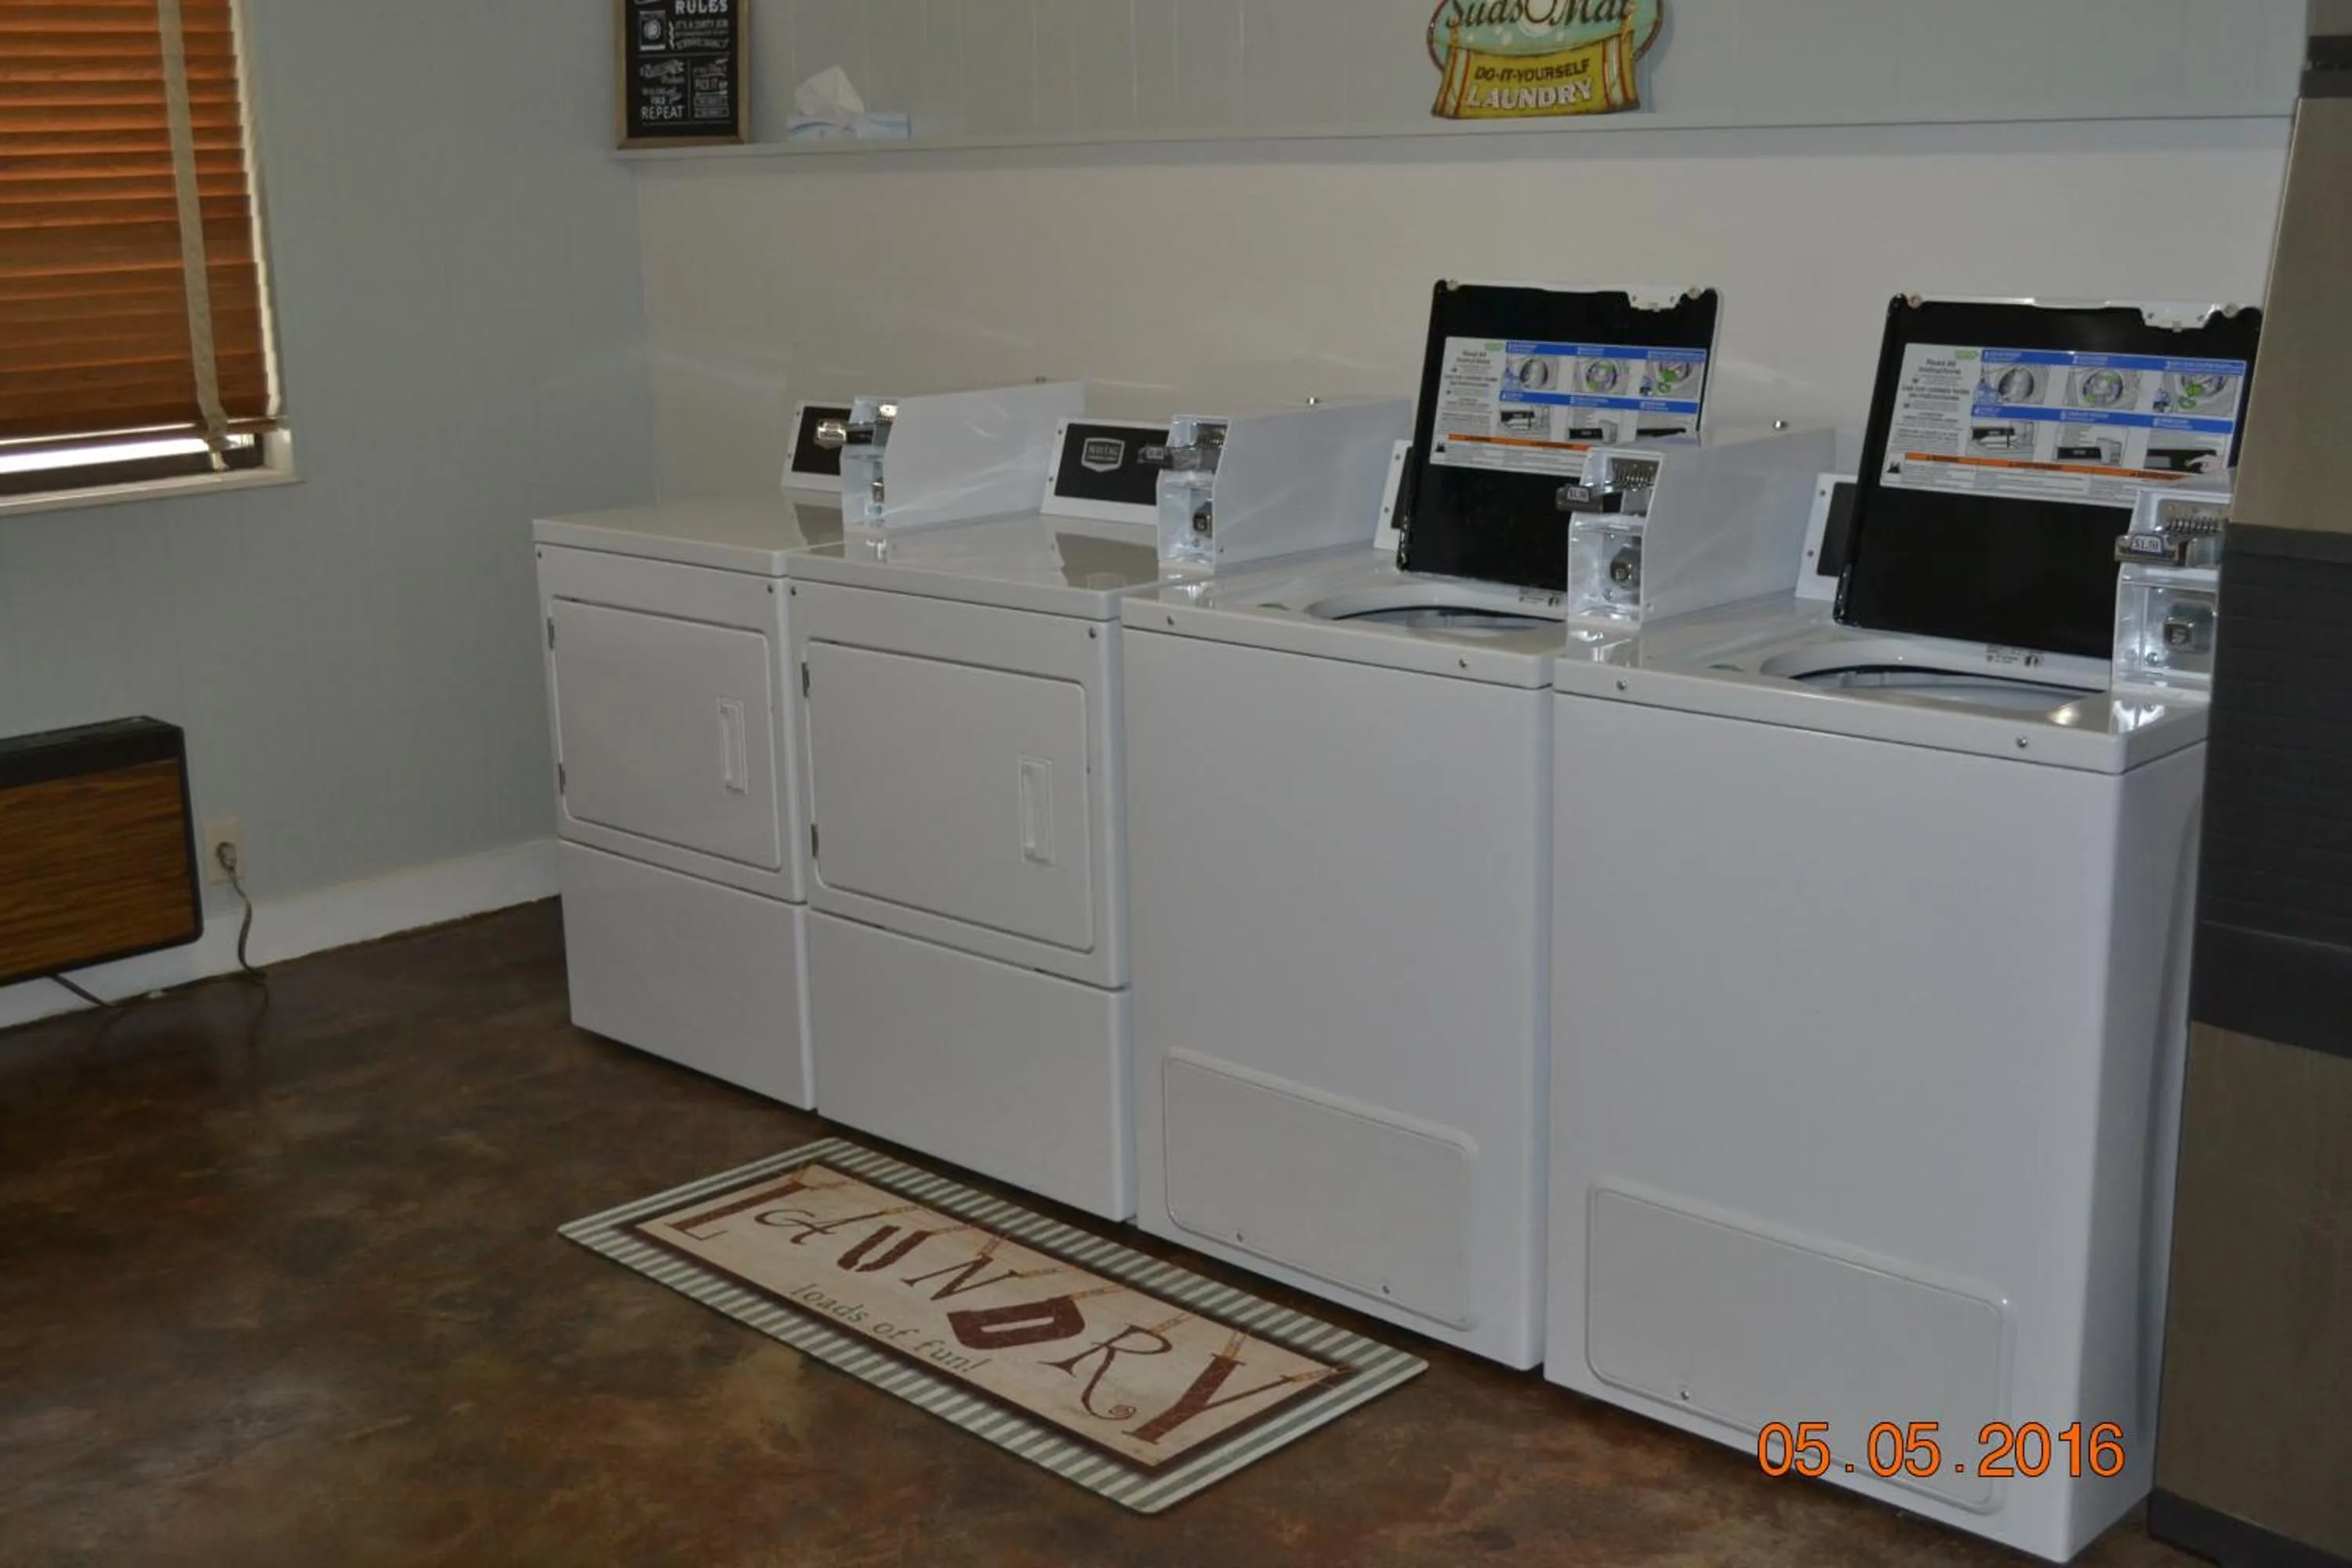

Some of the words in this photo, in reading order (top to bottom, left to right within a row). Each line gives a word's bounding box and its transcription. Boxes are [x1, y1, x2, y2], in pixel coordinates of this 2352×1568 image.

[675, 0, 728, 14] RULES
[1475, 59, 1590, 82] DO-IT-YOURSELF
[1467, 78, 1594, 109] LAUNDRY
[641, 105, 684, 120] REPEAT
[665, 1181, 1294, 1443] LAUNDRY
[790, 1282, 869, 1324] loads
[872, 1322, 920, 1340] of
[914, 1339, 993, 1374] fun!
